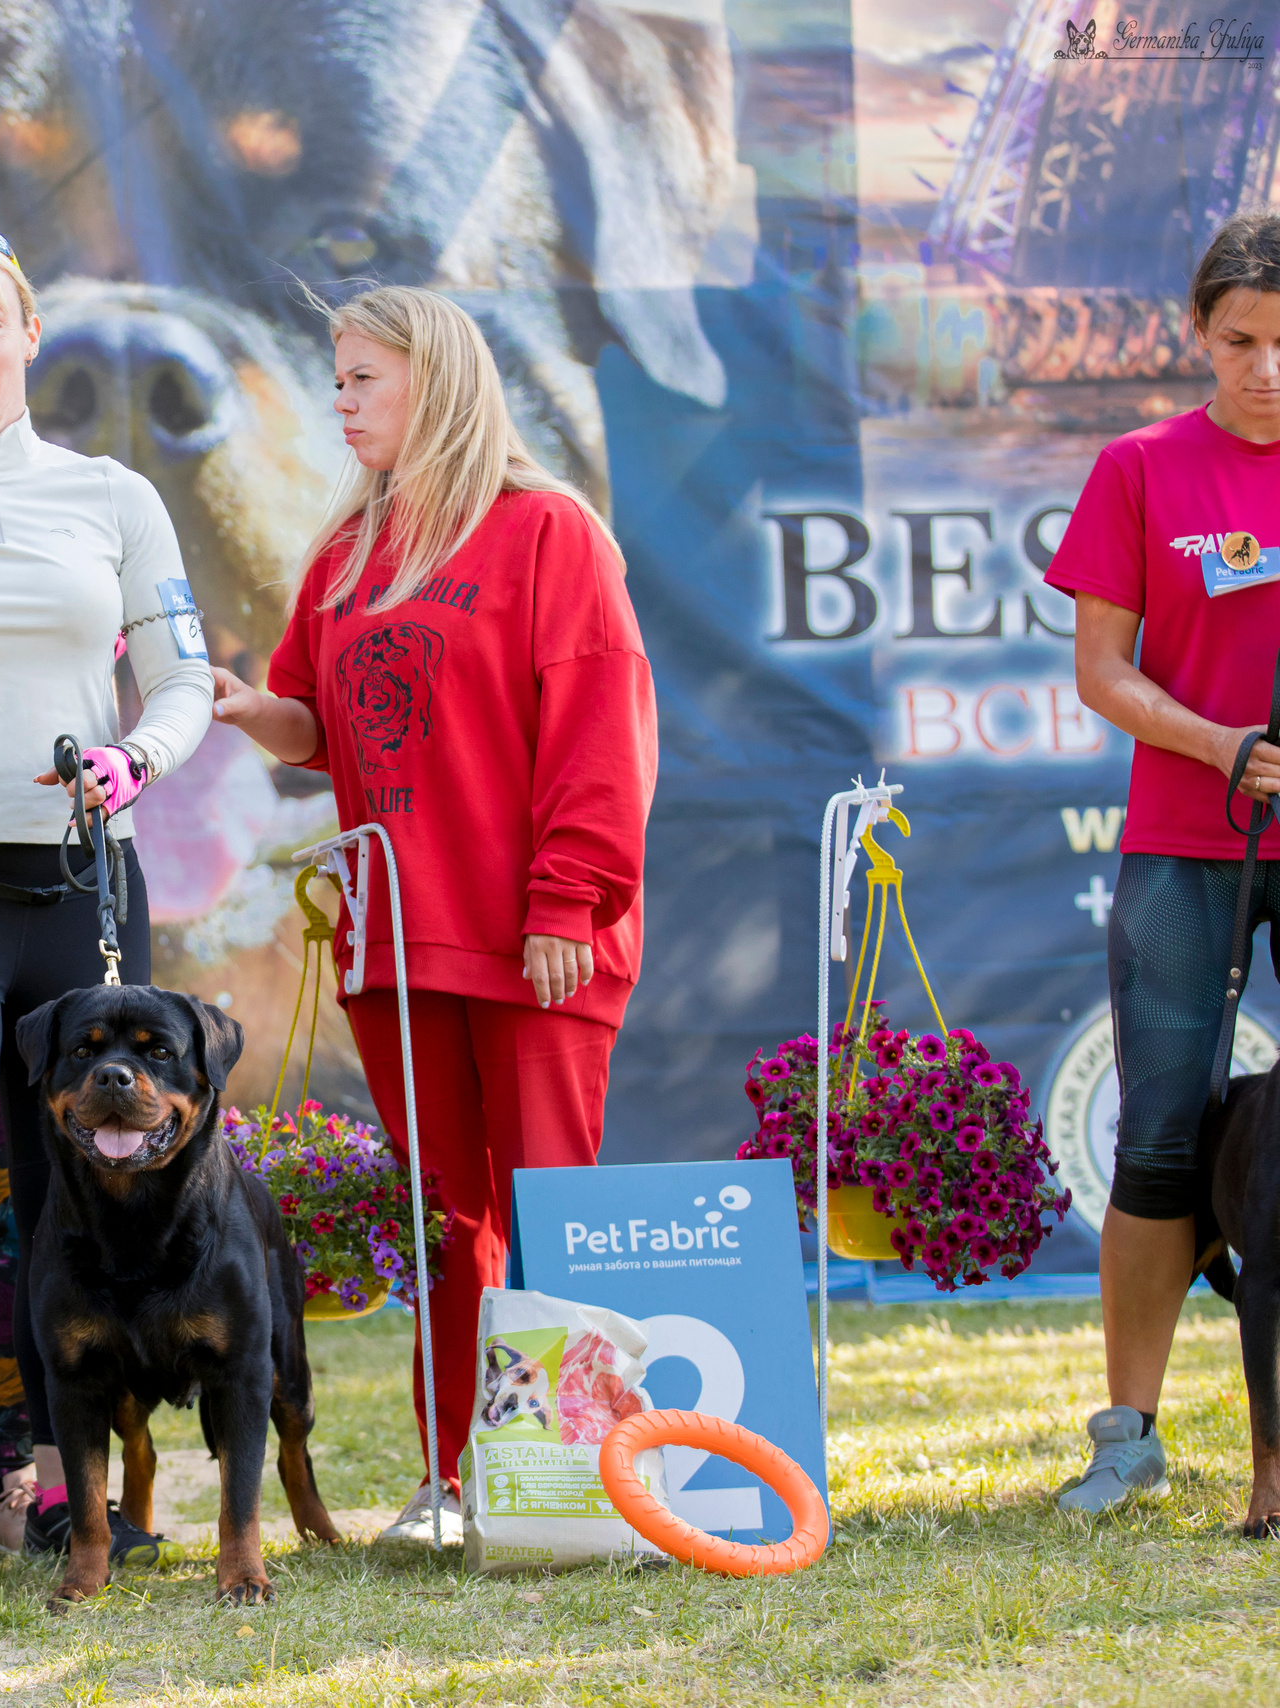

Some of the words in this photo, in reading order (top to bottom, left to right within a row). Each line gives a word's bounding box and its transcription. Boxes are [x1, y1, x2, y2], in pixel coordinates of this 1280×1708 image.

[334, 592, 357, 622] NO
[380, 786, 414, 813] LIFE
[568, 1262, 603, 1273] умная
[604, 1259, 641, 1271] забота
[643, 1261, 651, 1269] о
[652, 1258, 688, 1268] ваших
[689, 1256, 742, 1267] питомцах
[639, 1314, 764, 1531] 2
[501, 1446, 589, 1460] STATERA
[557, 1490, 585, 1498] ПОРОД
[521, 1500, 529, 1509] С
[530, 1501, 586, 1511] ЯГНЕНКОМ
[496, 1546, 554, 1558] STATERA
